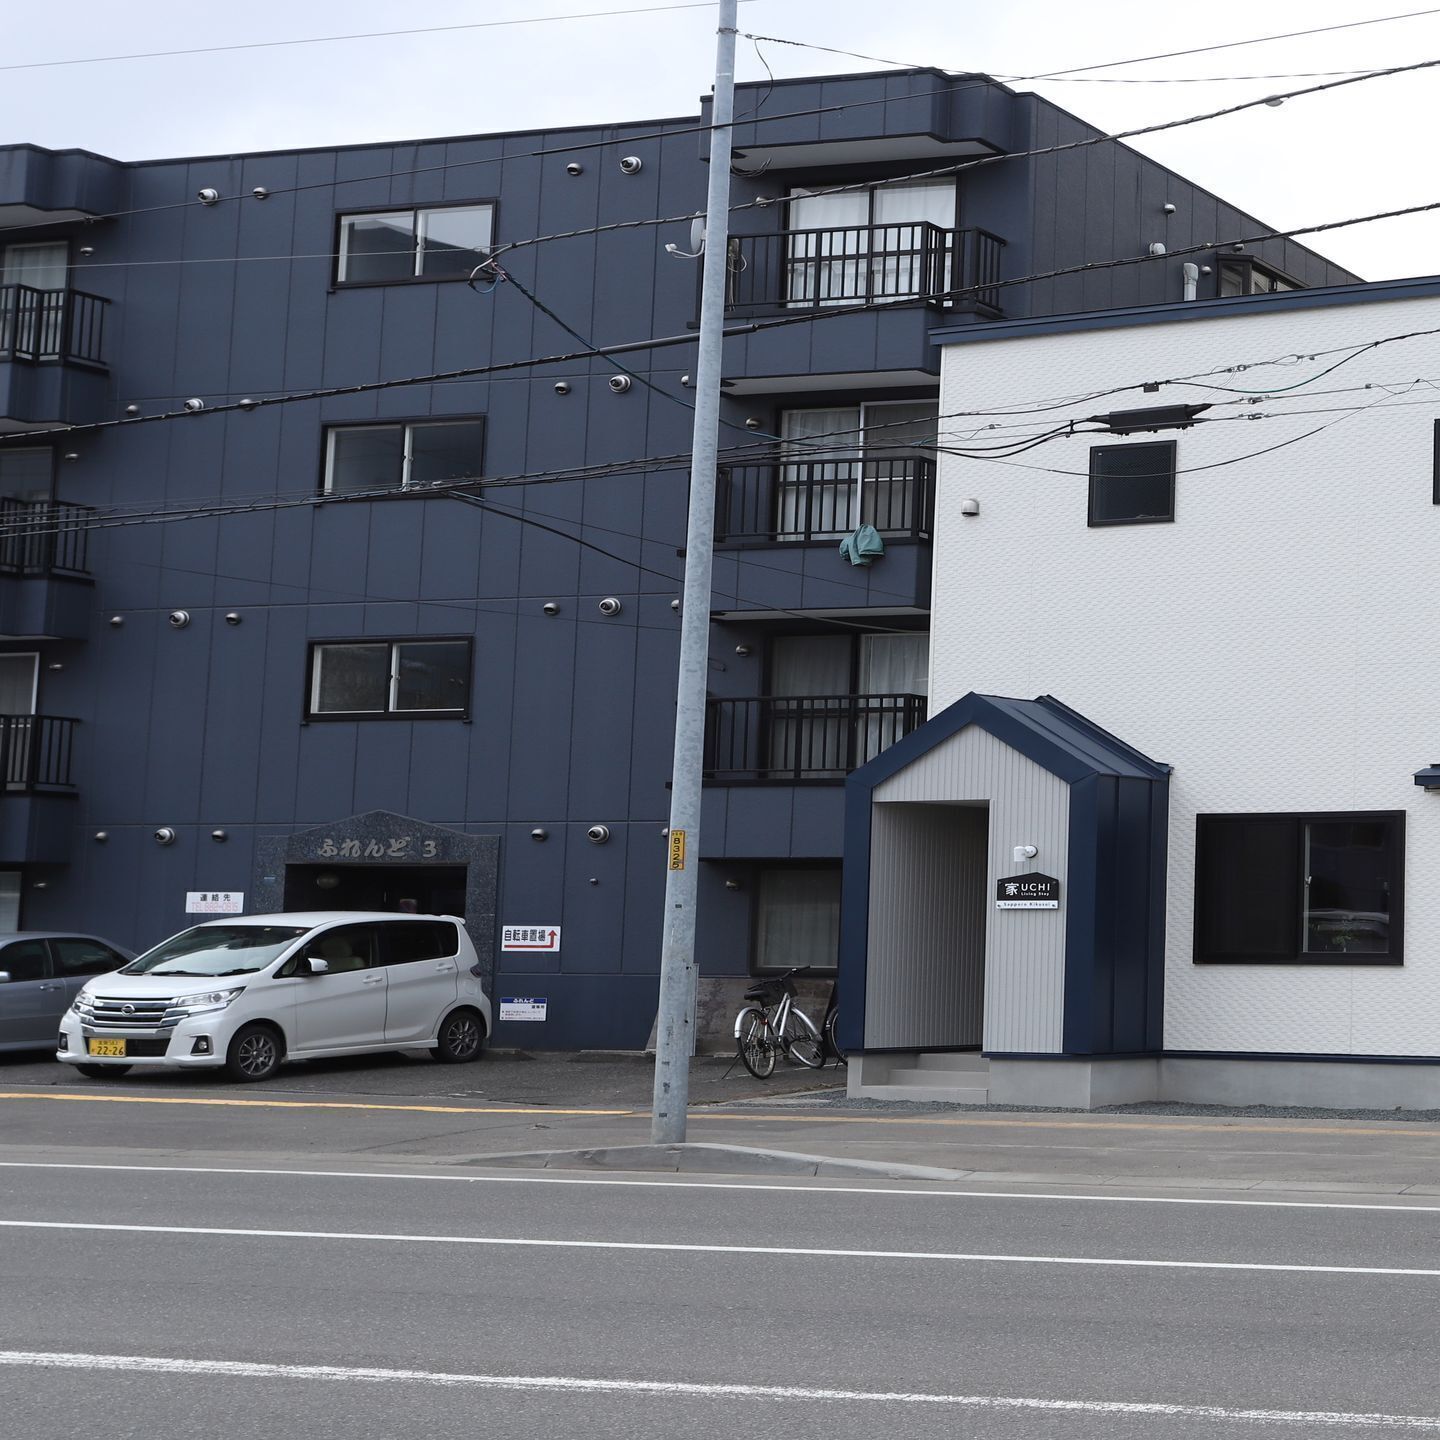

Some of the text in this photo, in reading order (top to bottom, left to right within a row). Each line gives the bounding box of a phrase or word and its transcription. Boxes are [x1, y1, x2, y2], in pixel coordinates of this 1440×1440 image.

[319, 836, 437, 858] ふれんど 3
[672, 838, 681, 869] 8325
[1005, 882, 1050, 895] 家 UCHI
[504, 929, 546, 942] 自転車置場
[97, 1046, 124, 1055] 22-26
